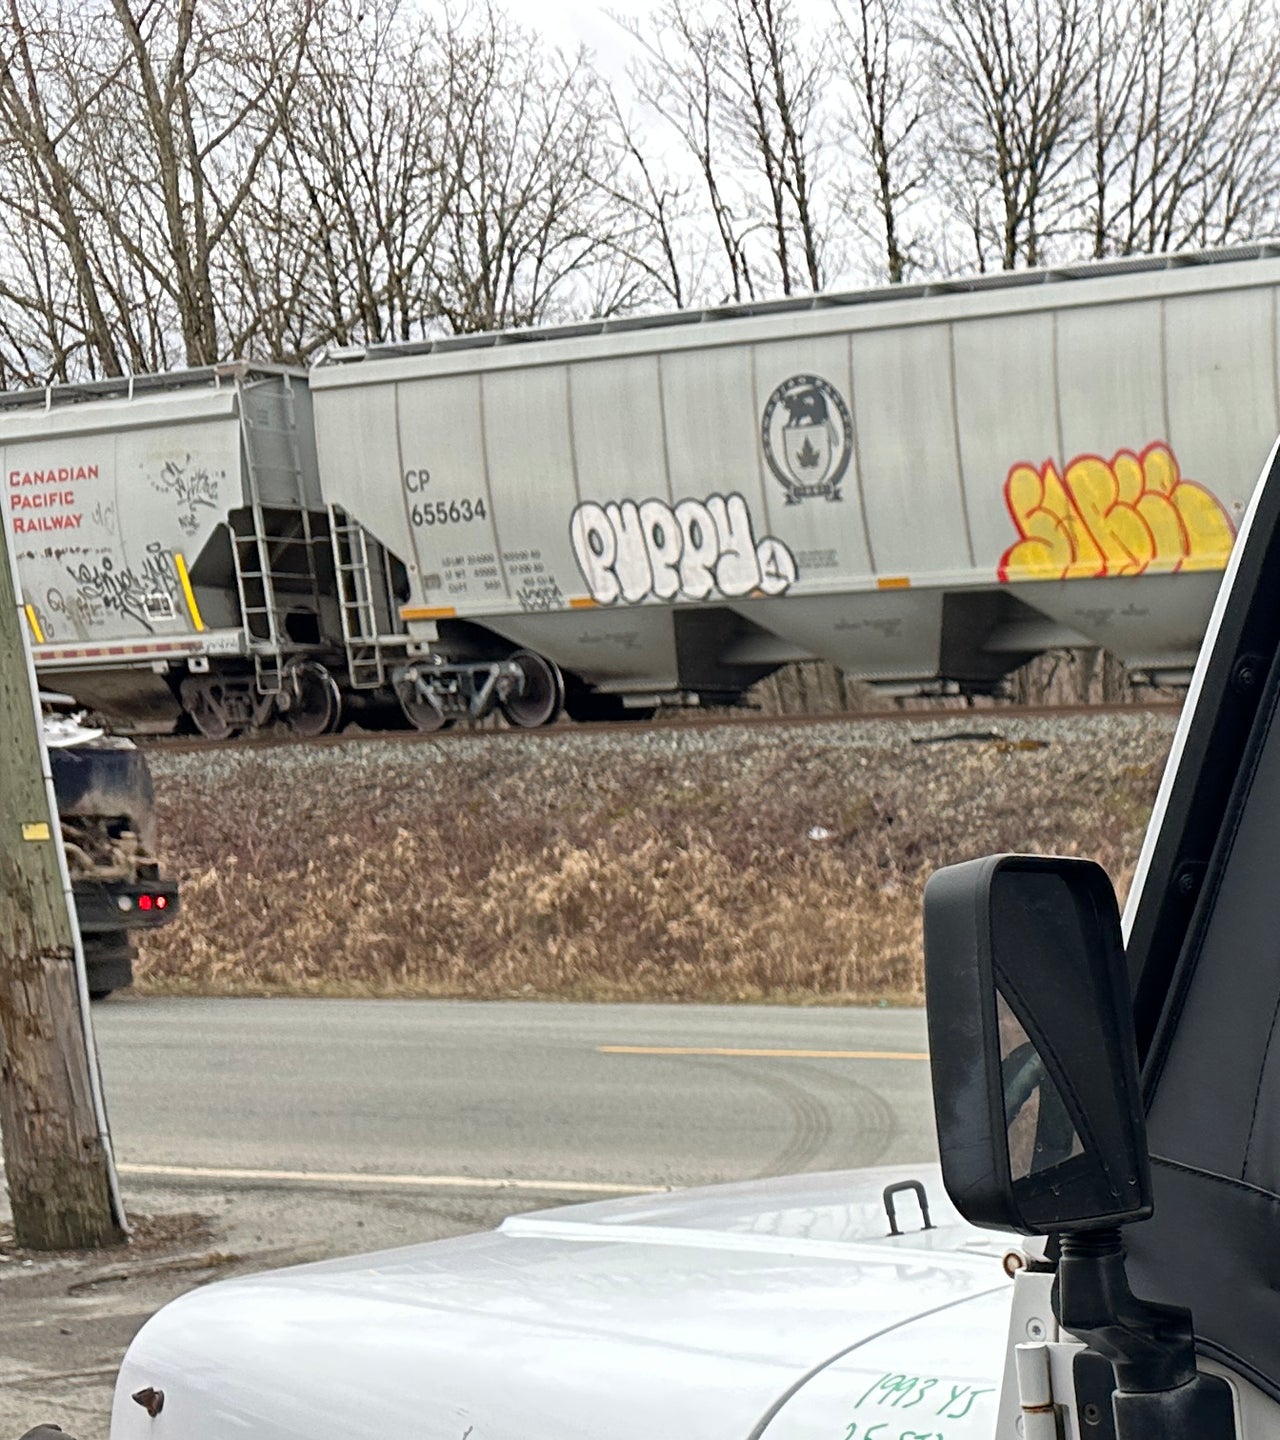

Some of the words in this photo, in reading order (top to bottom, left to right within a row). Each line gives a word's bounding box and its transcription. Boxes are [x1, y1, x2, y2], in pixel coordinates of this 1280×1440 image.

[9, 465, 99, 487] CANADIAN
[405, 469, 430, 493] CP
[11, 491, 75, 511] PACIFIC
[412, 497, 486, 527] 655634
[12, 513, 83, 534] RAILWAY
[854, 1372, 938, 1409] 1993
[936, 1385, 996, 1419] YJ
